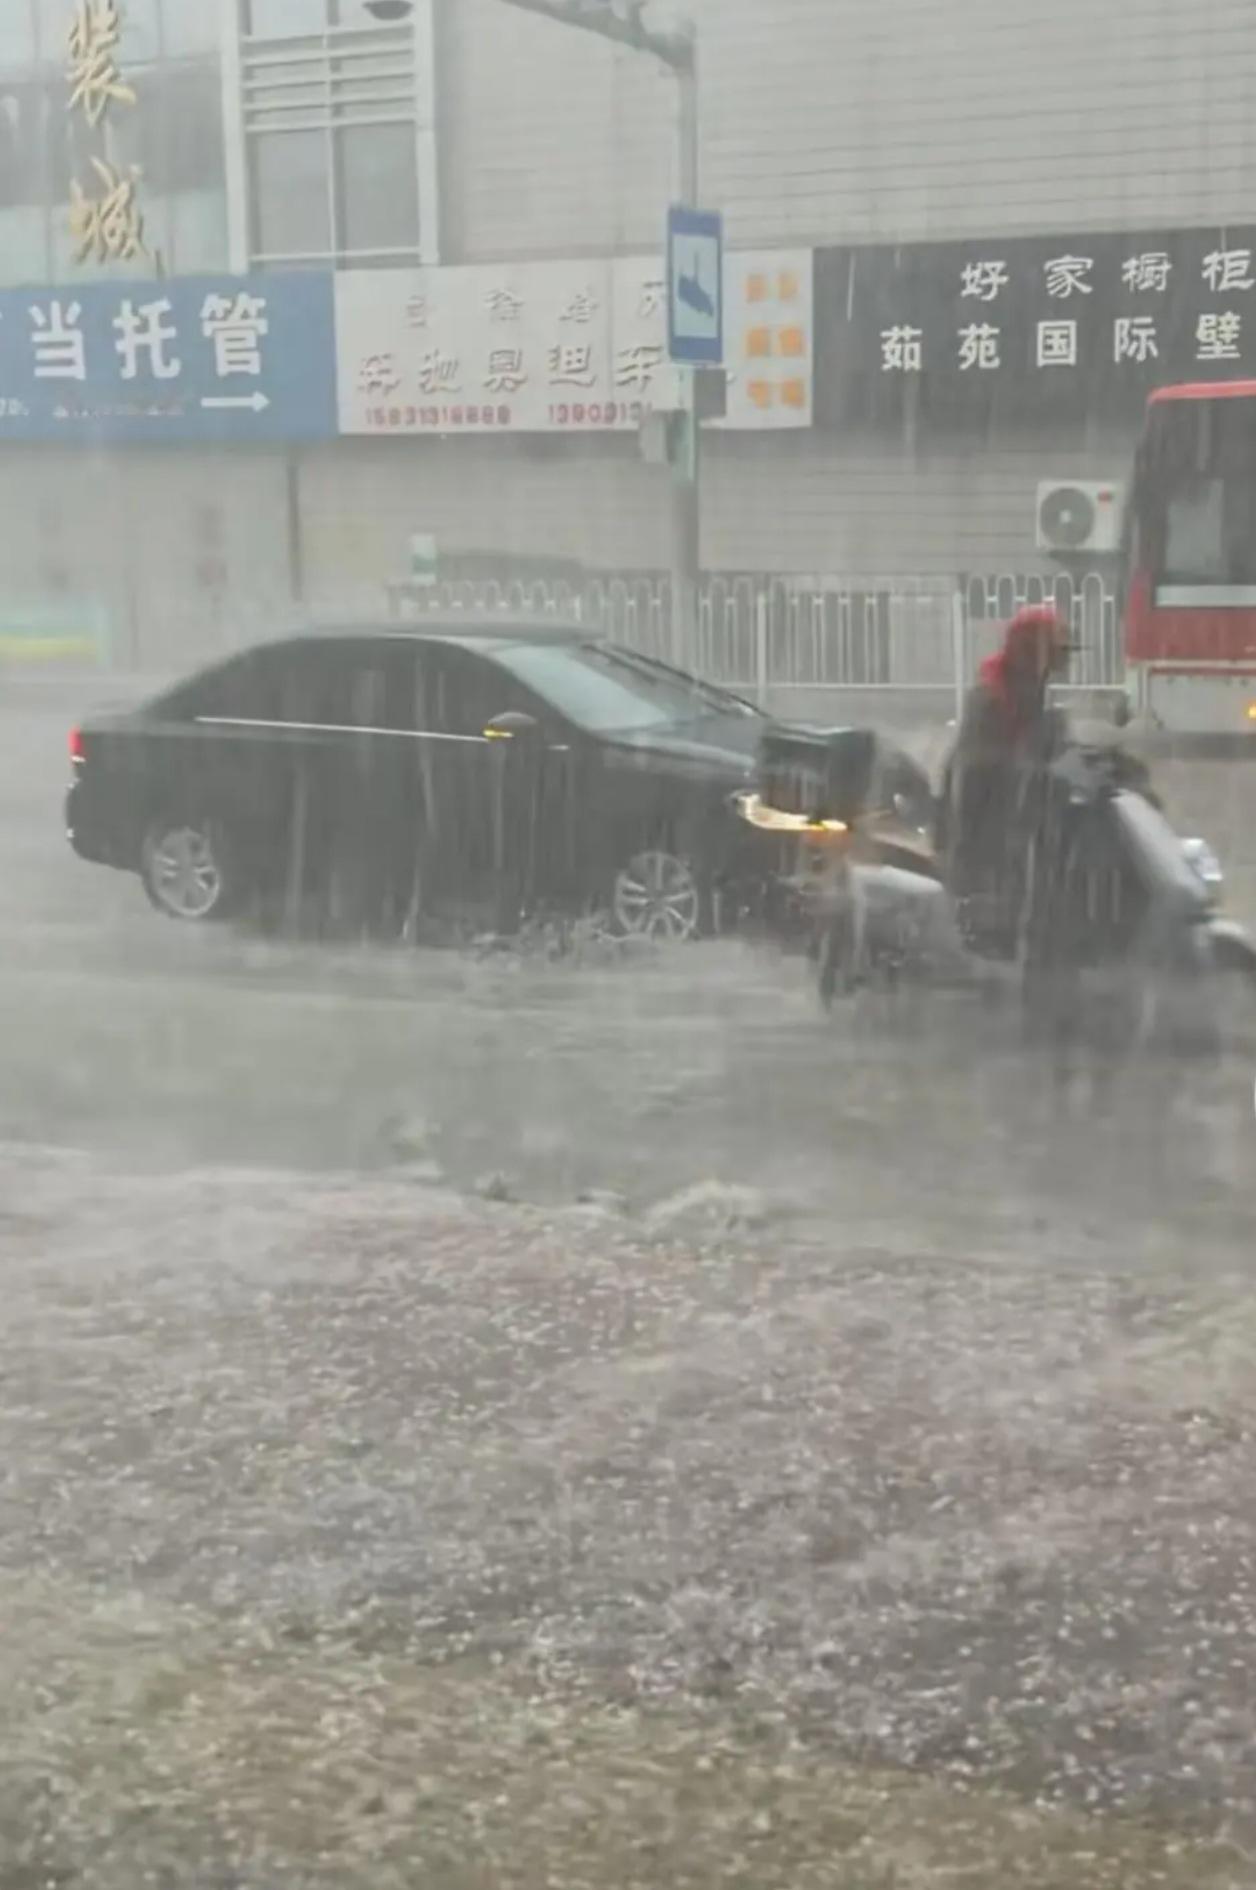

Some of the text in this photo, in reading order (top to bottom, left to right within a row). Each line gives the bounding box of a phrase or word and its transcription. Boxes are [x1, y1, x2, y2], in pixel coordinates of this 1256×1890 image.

[960, 251, 1256, 300] 好家橱柜
[28, 292, 269, 381] 当托管
[880, 312, 1241, 371] 茹苑国际壁
